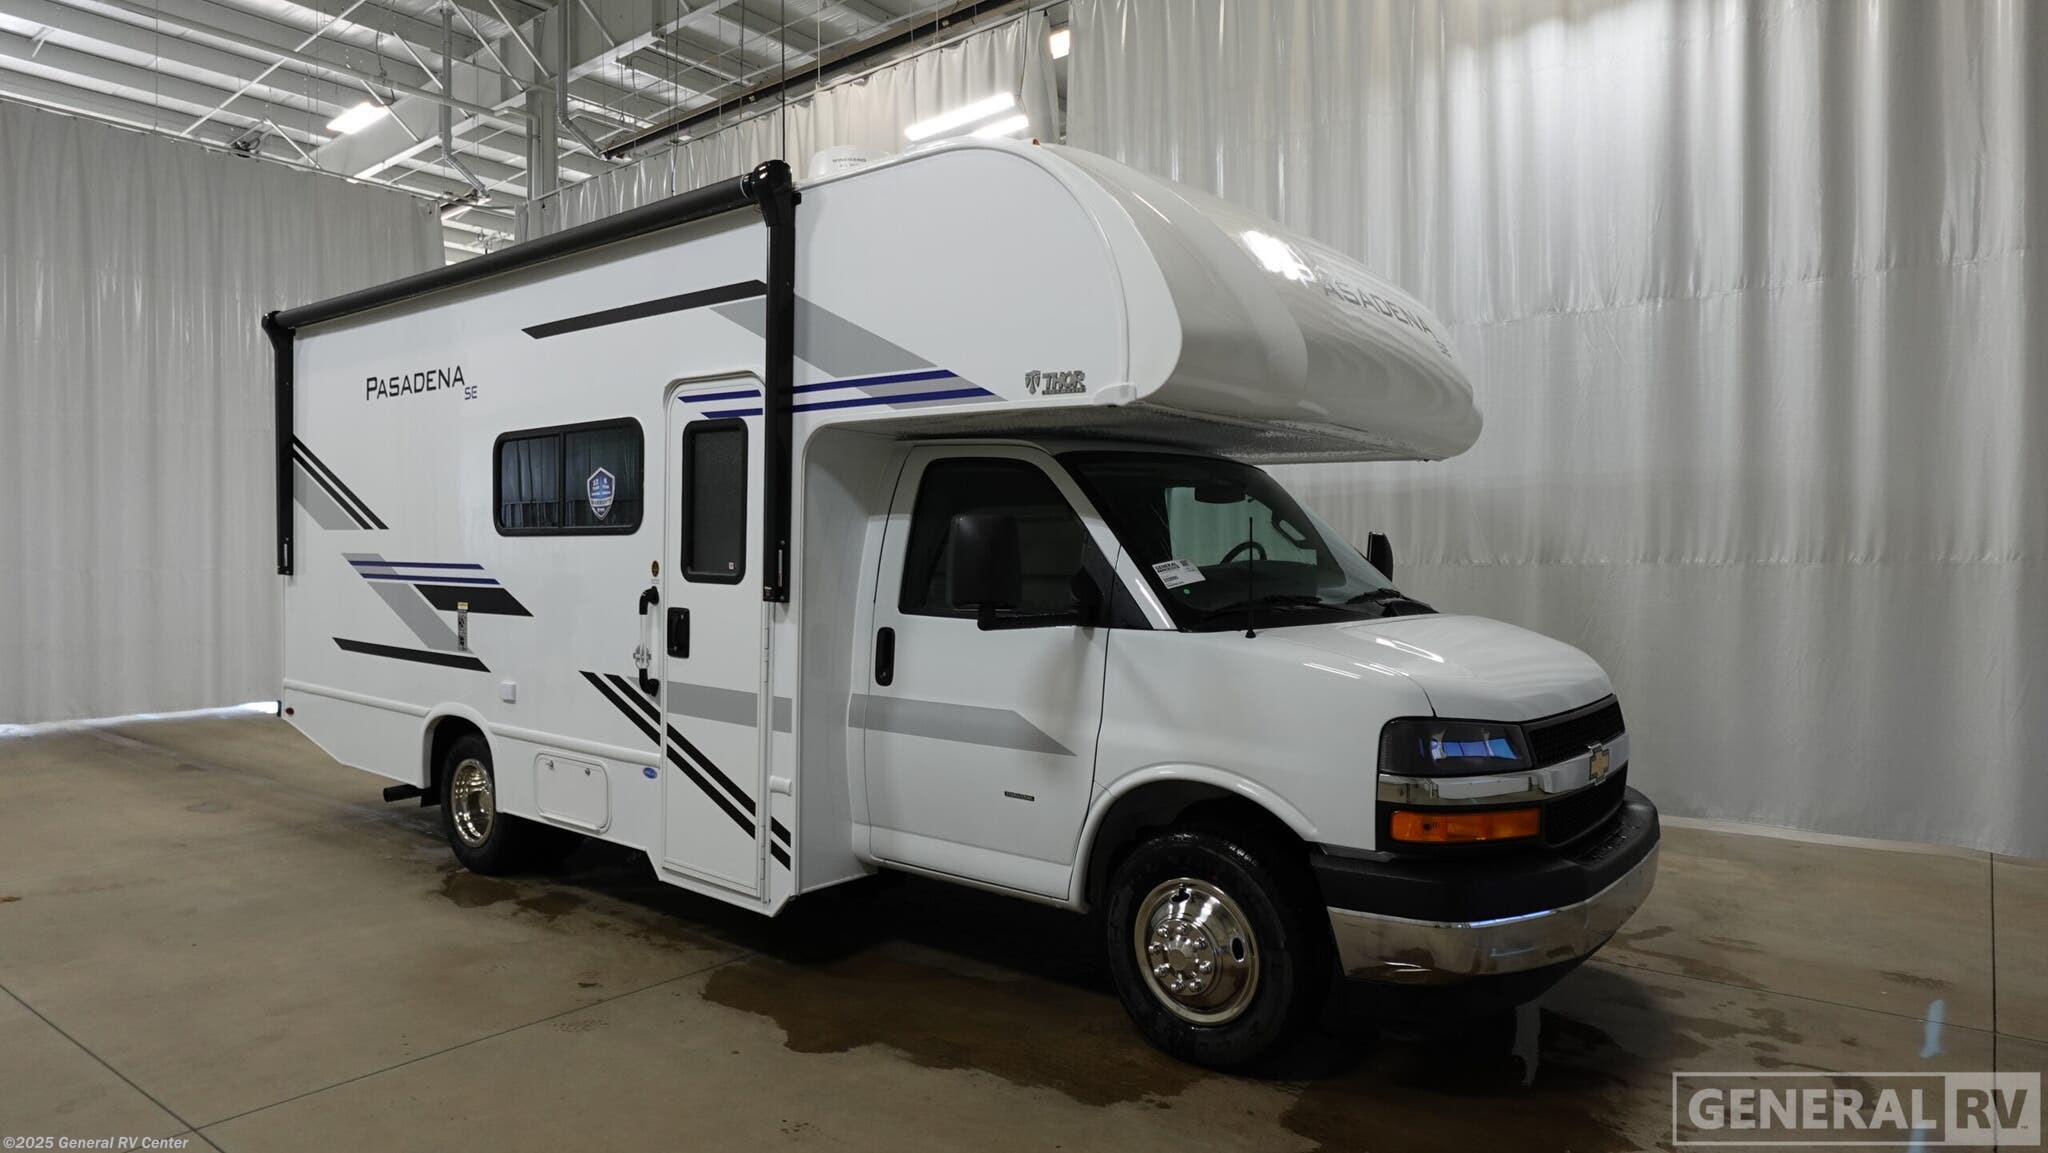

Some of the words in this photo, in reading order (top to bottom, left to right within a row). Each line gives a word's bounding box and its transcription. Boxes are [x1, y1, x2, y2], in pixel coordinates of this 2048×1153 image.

[366, 365, 465, 400] PASADENA
[464, 385, 478, 400] SE
[1042, 370, 1086, 390] THOR
